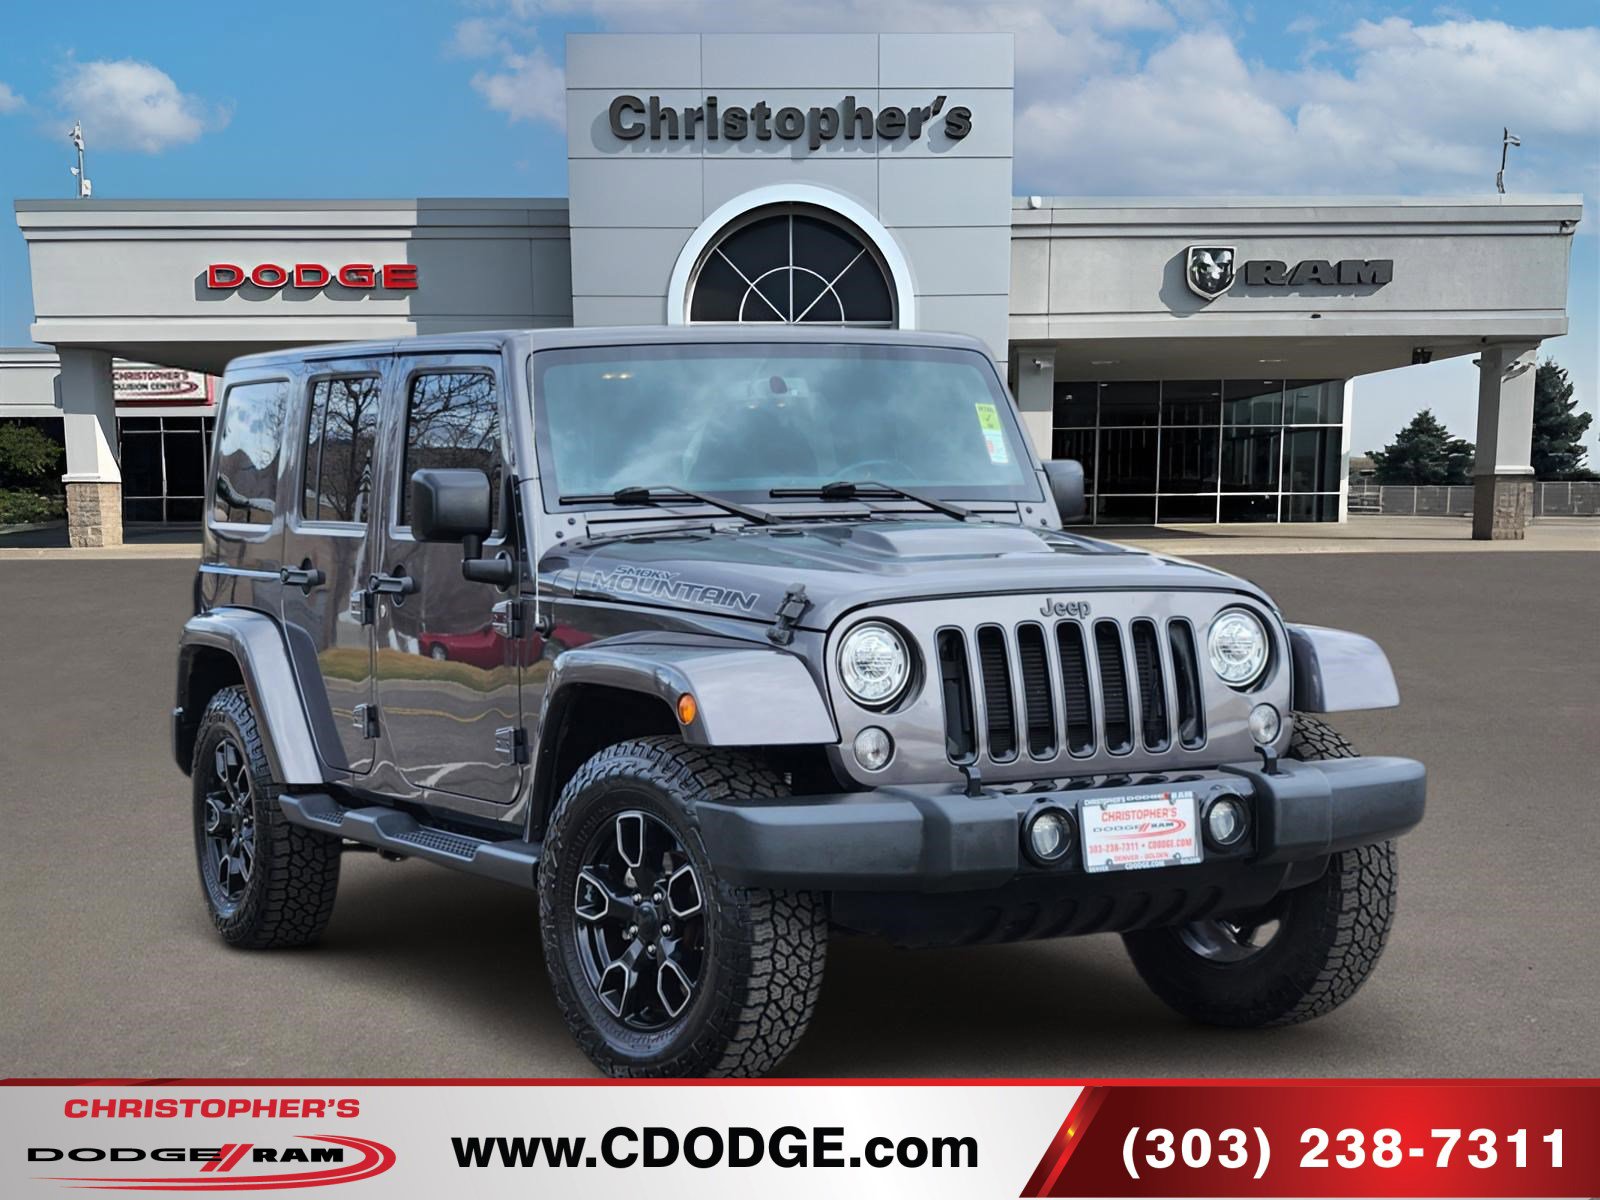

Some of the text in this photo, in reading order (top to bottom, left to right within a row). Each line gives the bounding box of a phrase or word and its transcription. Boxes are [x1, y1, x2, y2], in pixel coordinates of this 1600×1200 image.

[608, 94, 973, 150] Christopher's
[207, 263, 418, 289] DODGE
[1245, 259, 1394, 285] RAM
[113, 382, 181, 391] OLLISION CENTER
[615, 564, 680, 580] SMOKY
[592, 570, 760, 612] MOUNTAIN
[1040, 598, 1091, 620] Jeep
[1101, 807, 1177, 822] CHRISTOPHER'S
[1093, 823, 1140, 833] DODGE
